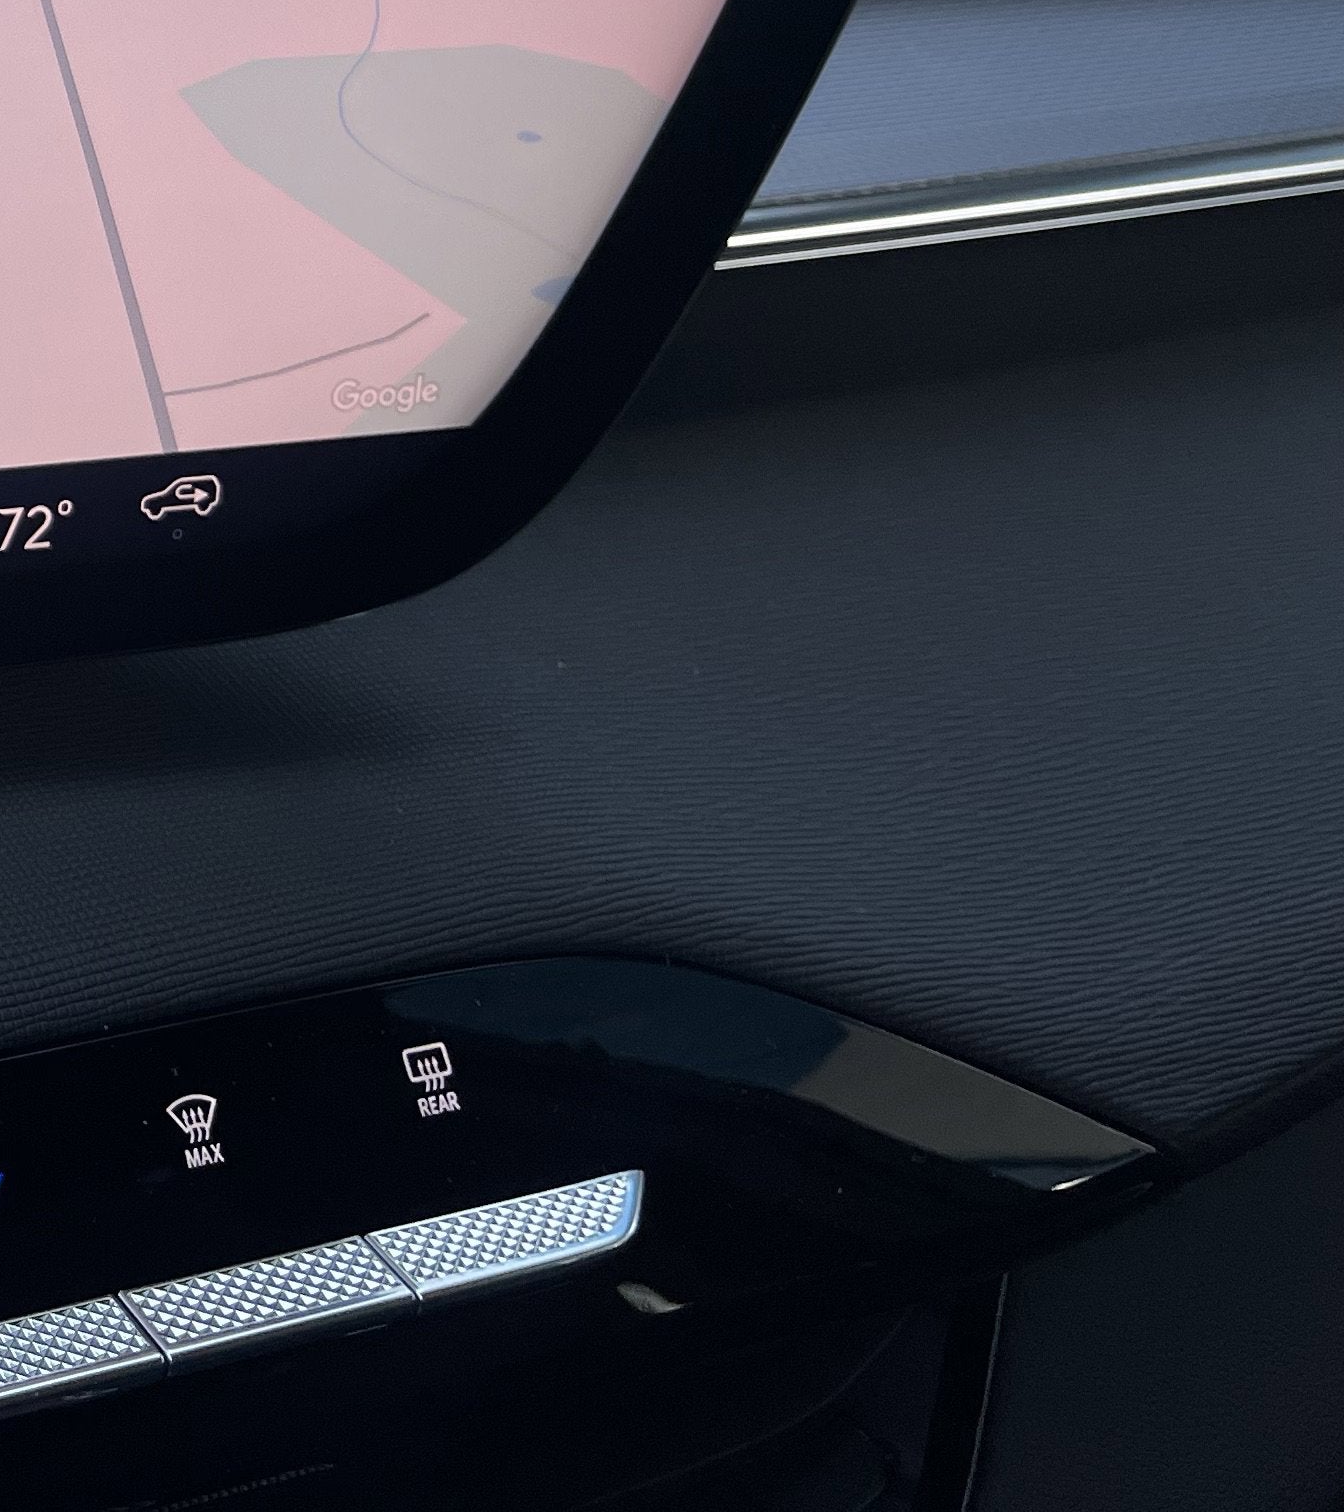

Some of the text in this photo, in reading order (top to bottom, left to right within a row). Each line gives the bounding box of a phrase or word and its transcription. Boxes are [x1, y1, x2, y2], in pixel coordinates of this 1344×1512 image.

[332, 374, 439, 413] Google
[417, 1090, 461, 1118] REAR
[184, 1143, 225, 1169] MAX
